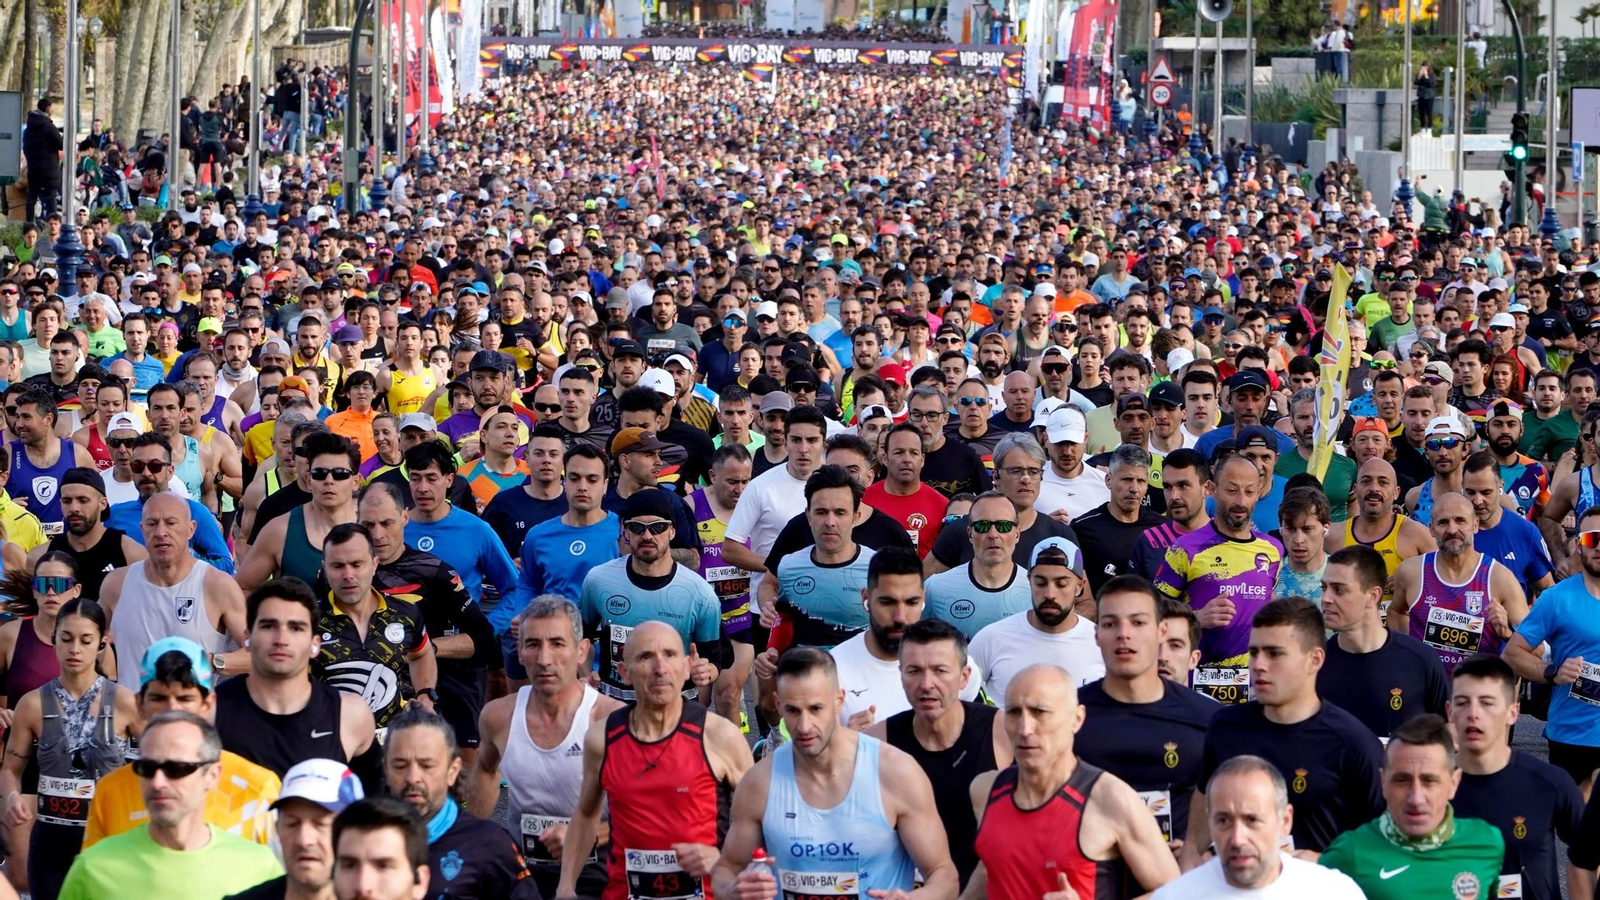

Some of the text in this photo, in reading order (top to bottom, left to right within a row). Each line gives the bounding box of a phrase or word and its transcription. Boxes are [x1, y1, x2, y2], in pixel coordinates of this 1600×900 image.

[528, 44, 551, 59] BAY
[602, 45, 623, 60] BAY
[675, 46, 698, 62] BAY
[757, 44, 785, 63] BAY
[837, 49, 859, 64] BAY
[909, 50, 931, 65] BAY
[982, 52, 1005, 66] BAY
[1155, 90, 1168, 99] 30
[594, 402, 613, 423] 25
[515, 521, 525, 529] 16
[717, 579, 747, 593] 1466
[1219, 582, 1267, 597] PRIVILEGE
[610, 600, 626, 608] Kiwi
[954, 603, 971, 611] Kiwi
[1434, 612, 1442, 621] 25
[615, 629, 623, 638] 25
[1440, 626, 1469, 645] 696
[1208, 685, 1237, 700] 750
[63, 781, 79, 791] BAY
[49, 796, 80, 815] 932
[527, 821, 537, 830] 25
[645, 853, 660, 865] VIG
[652, 873, 679, 891] 43
[786, 875, 838, 887] 25 VIG BAY
